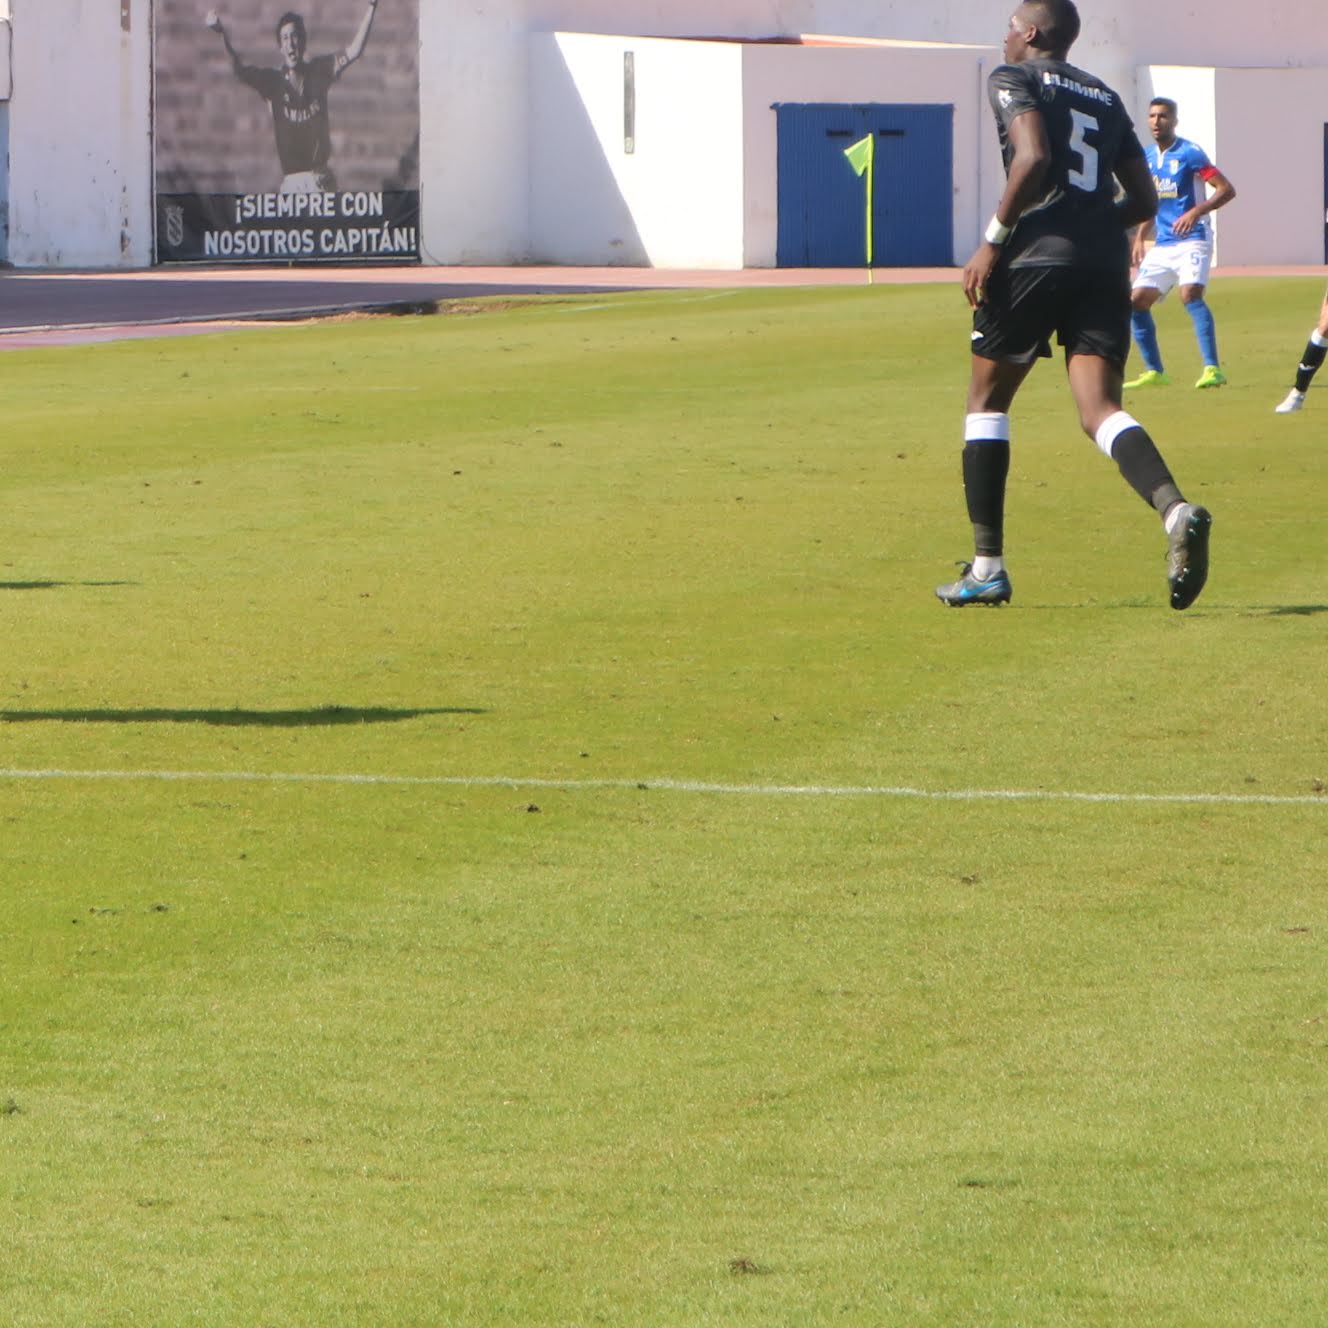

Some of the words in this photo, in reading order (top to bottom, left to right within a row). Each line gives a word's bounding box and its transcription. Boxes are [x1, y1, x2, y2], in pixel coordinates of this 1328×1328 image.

[1067, 107, 1099, 193] 5
[235, 191, 334, 223] ¡SIEMPRE
[341, 191, 384, 216] CON
[204, 229, 314, 256] NOSOTROS
[320, 221, 417, 253] CAPITÁN!
